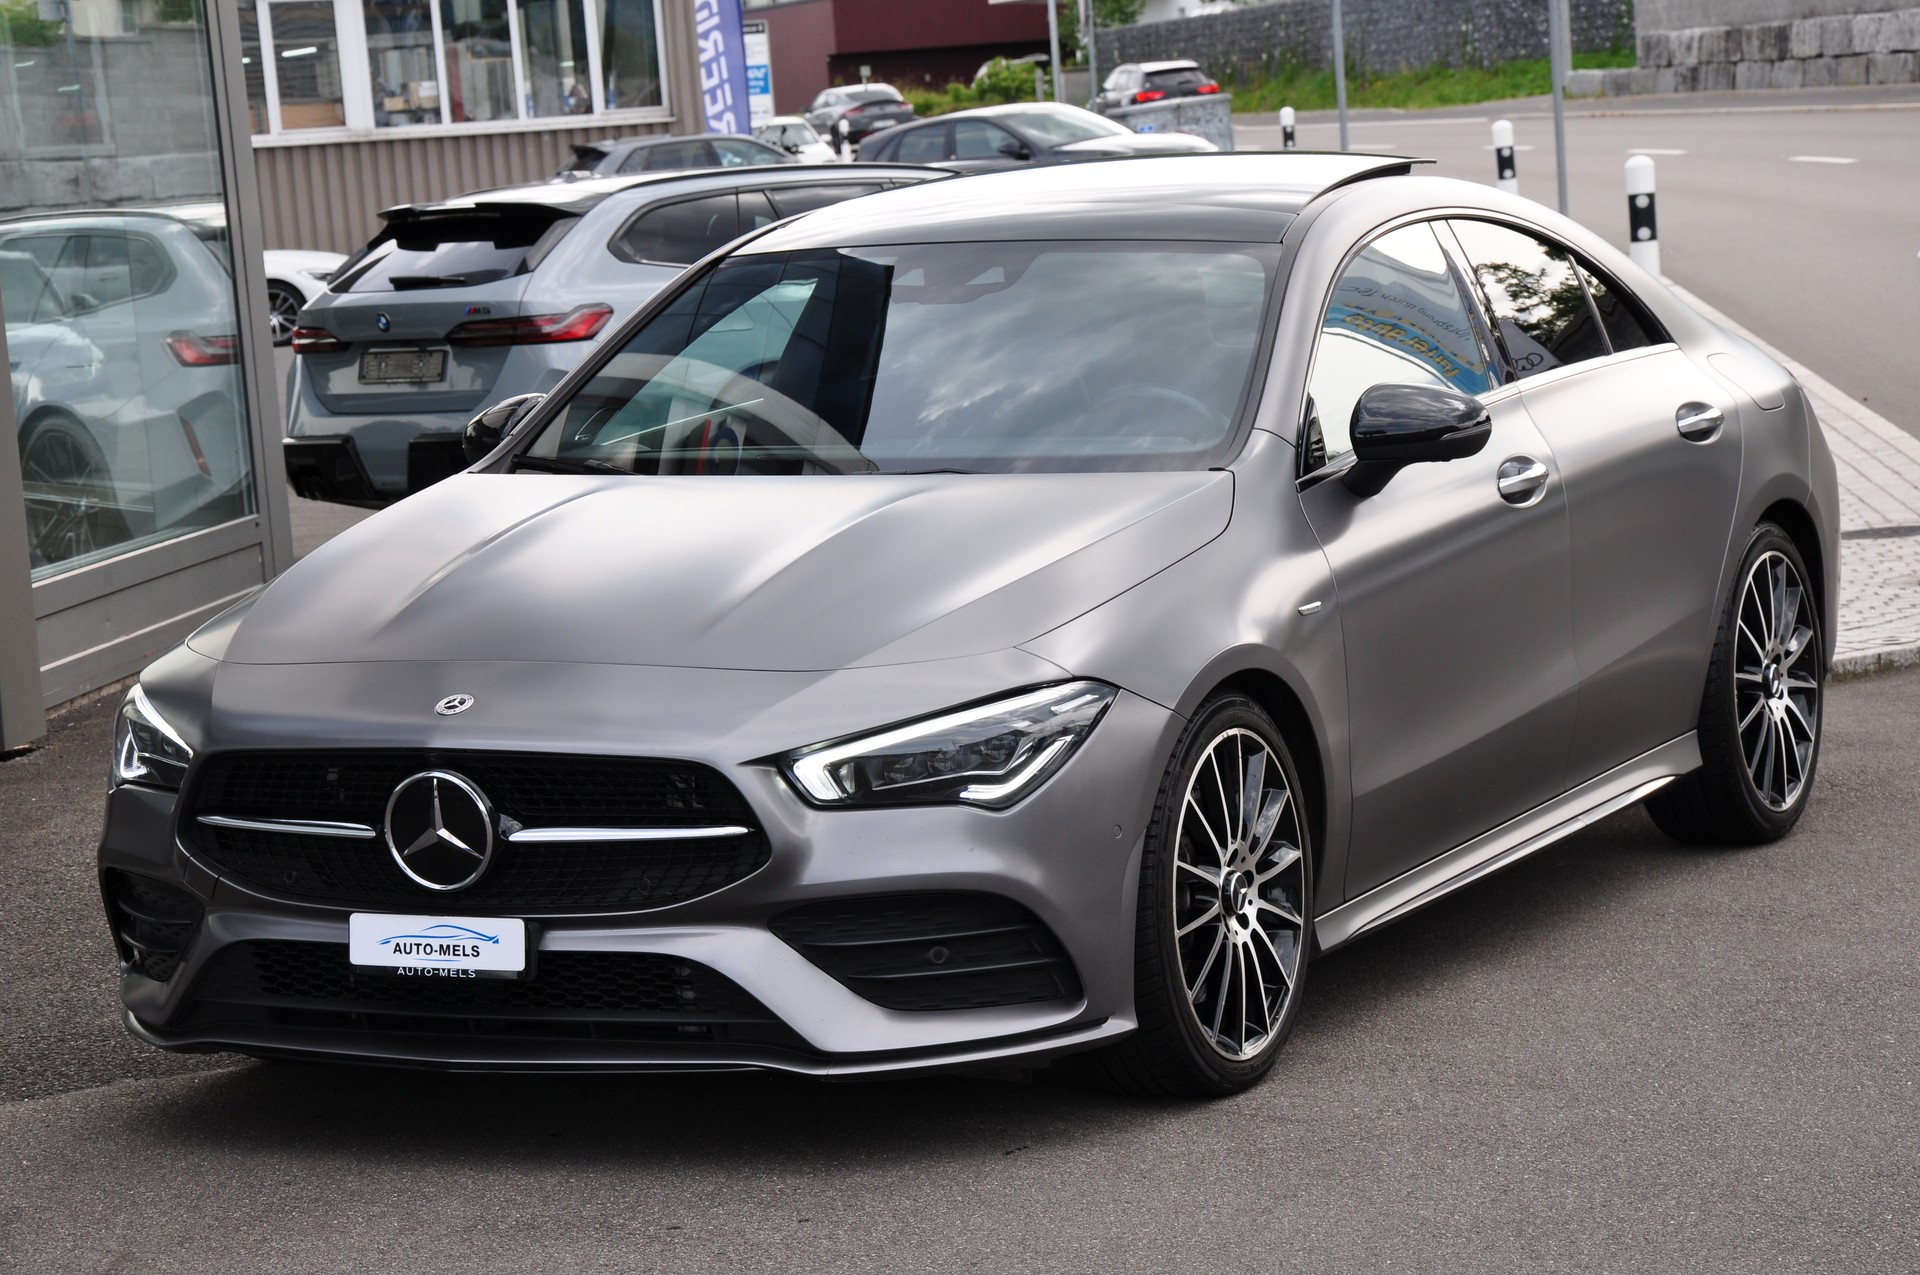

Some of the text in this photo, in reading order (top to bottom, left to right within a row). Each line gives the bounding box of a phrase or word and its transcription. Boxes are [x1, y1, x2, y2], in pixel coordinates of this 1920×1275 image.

[1380, 293, 1417, 309] durch
[1344, 313, 1462, 378] furrer auto
[393, 942, 480, 958] AUTO-MELS
[397, 966, 476, 978] AUTO-MELS
